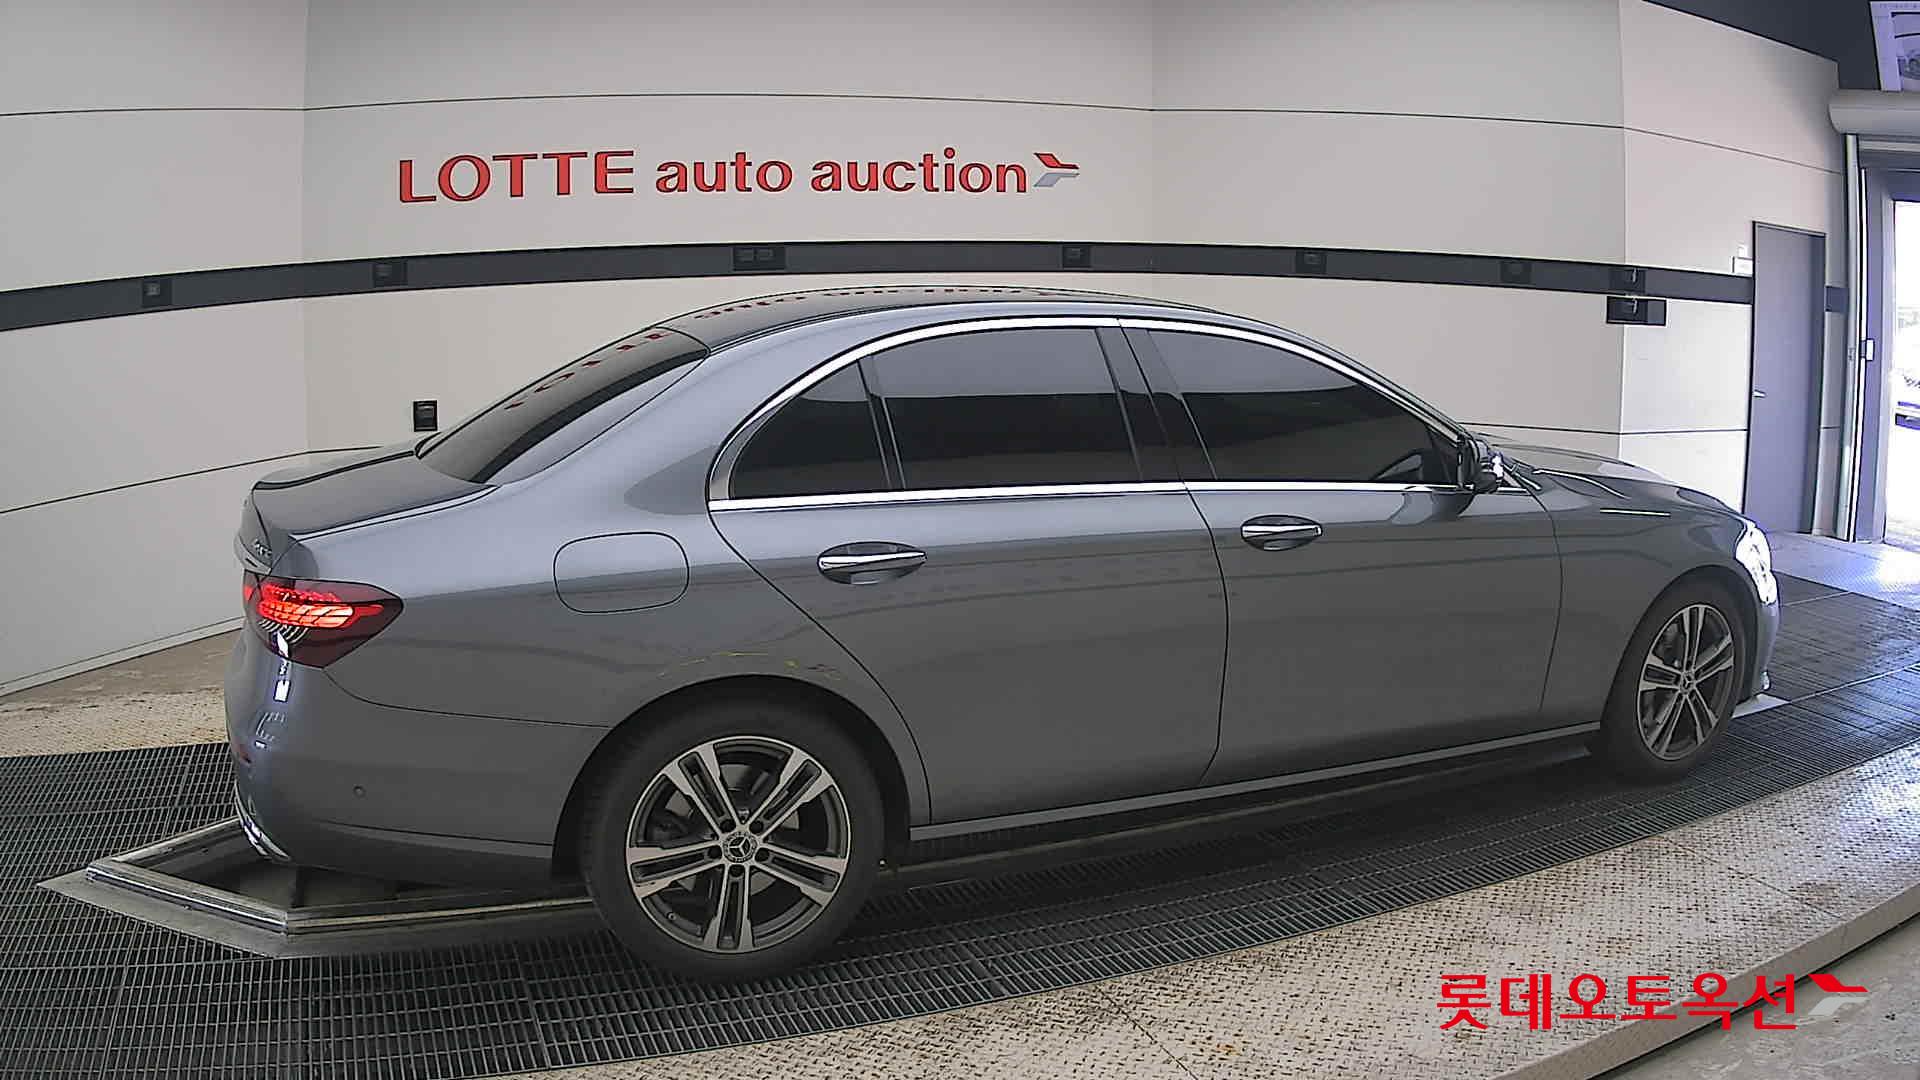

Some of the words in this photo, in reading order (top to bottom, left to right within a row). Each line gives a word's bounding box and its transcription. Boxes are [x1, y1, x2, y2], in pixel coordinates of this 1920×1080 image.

[399, 150, 636, 203] LOTTE
[656, 152, 794, 194] auto
[811, 147, 1029, 193] auction
